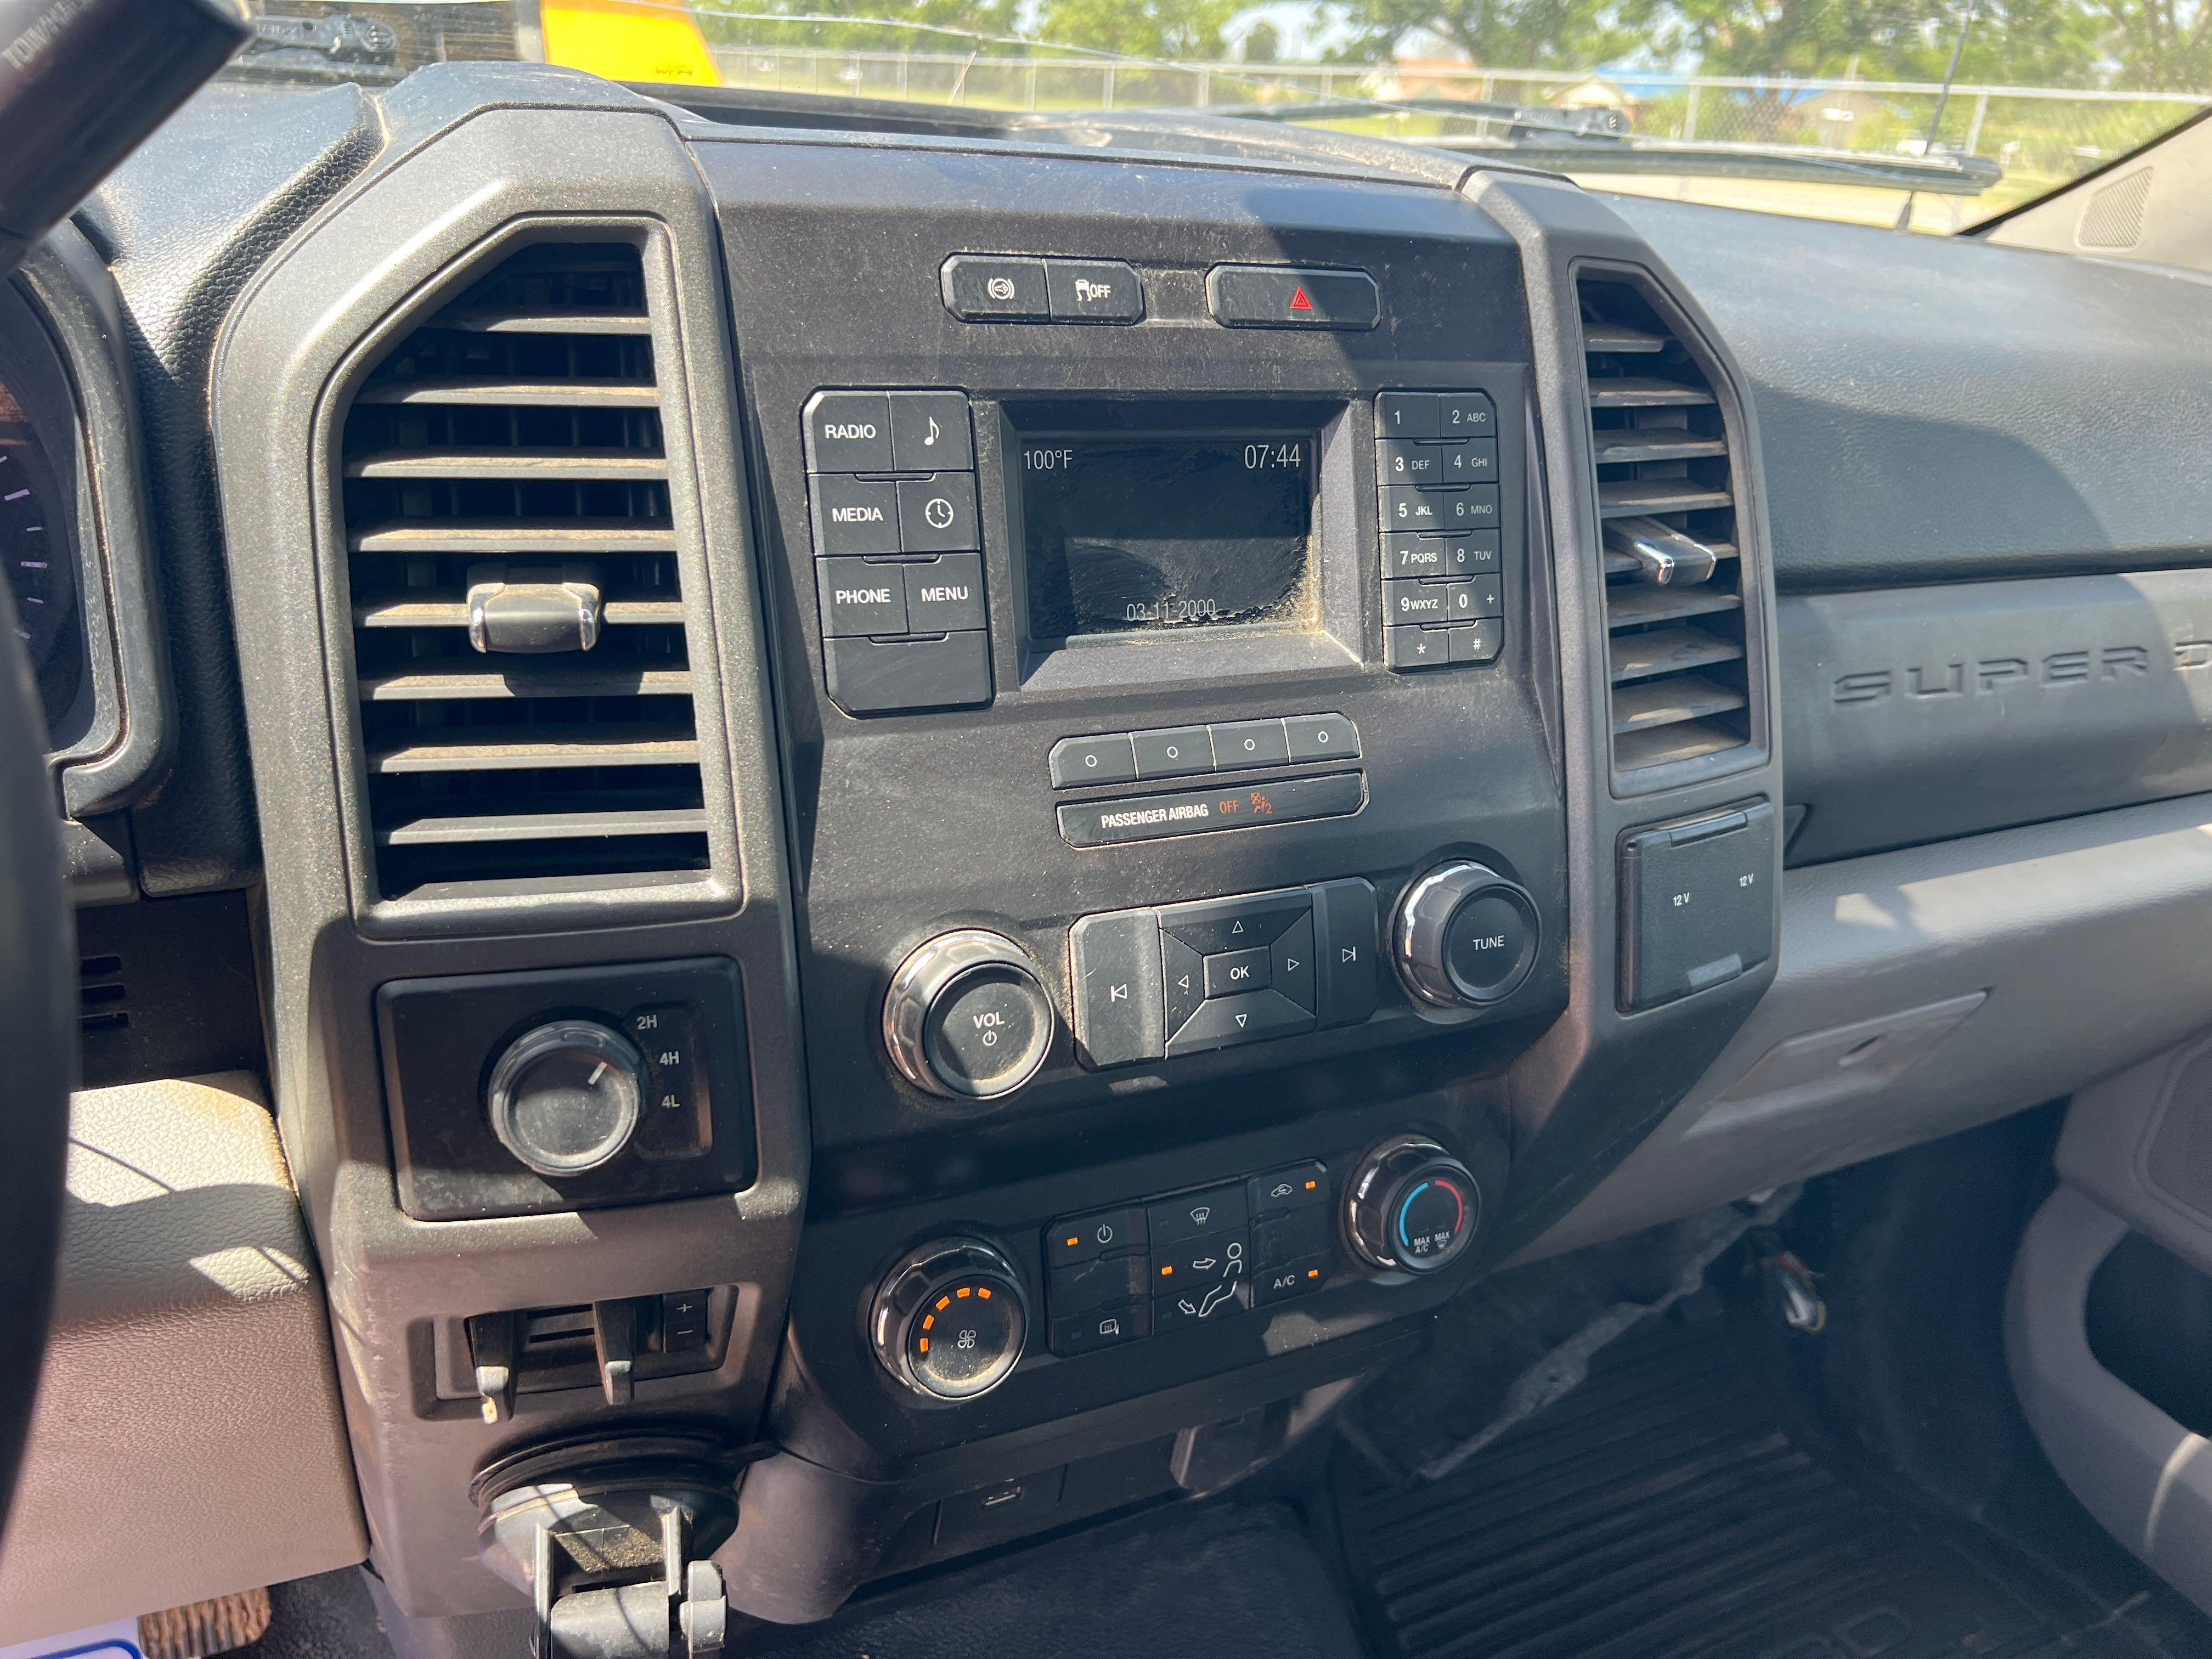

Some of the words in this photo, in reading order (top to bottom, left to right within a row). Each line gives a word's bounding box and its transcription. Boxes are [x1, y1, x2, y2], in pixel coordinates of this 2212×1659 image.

[1092, 284, 1111, 298] OFF
[1395, 411, 1400, 424] 1
[1453, 410, 1459, 424] 2
[1467, 413, 1486, 422] ABC
[825, 425, 876, 438] RADIO
[1024, 450, 1072, 469] 100°F
[1245, 444, 1300, 469] 07:44
[1454, 455, 1462, 468] 4
[1471, 458, 1487, 467] GHI
[1396, 457, 1404, 471] 3
[1412, 460, 1430, 470] DEF
[832, 507, 883, 522] MEDIA
[1399, 503, 1407, 517] 5
[1415, 506, 1432, 516] JKL
[1457, 503, 1464, 516] 6
[1471, 505, 1492, 514] MNO
[1457, 549, 1465, 562] 8
[1474, 551, 1491, 560] TUV
[836, 589, 890, 603] PHONE
[922, 586, 968, 601] MENU
[1459, 594, 1468, 608] 0
[1832, 644, 2148, 706] SUPER
[1101, 809, 1167, 828] PASSENGER
[1169, 804, 1209, 820] AIRBAG
[1220, 800, 1238, 813] OFF
[1473, 935, 1504, 950] TUNE
[1231, 966, 1249, 979] OK
[637, 1015, 657, 1029] 2H
[973, 1012, 1005, 1028] VOL
[660, 1051, 679, 1065] 4H
[662, 1095, 680, 1108] 4L
[1414, 1236, 1430, 1246] MAX
[1435, 1231, 1449, 1242] MAX
[1415, 1244, 1429, 1254] A/C
[1274, 1275, 1295, 1289] A/C
